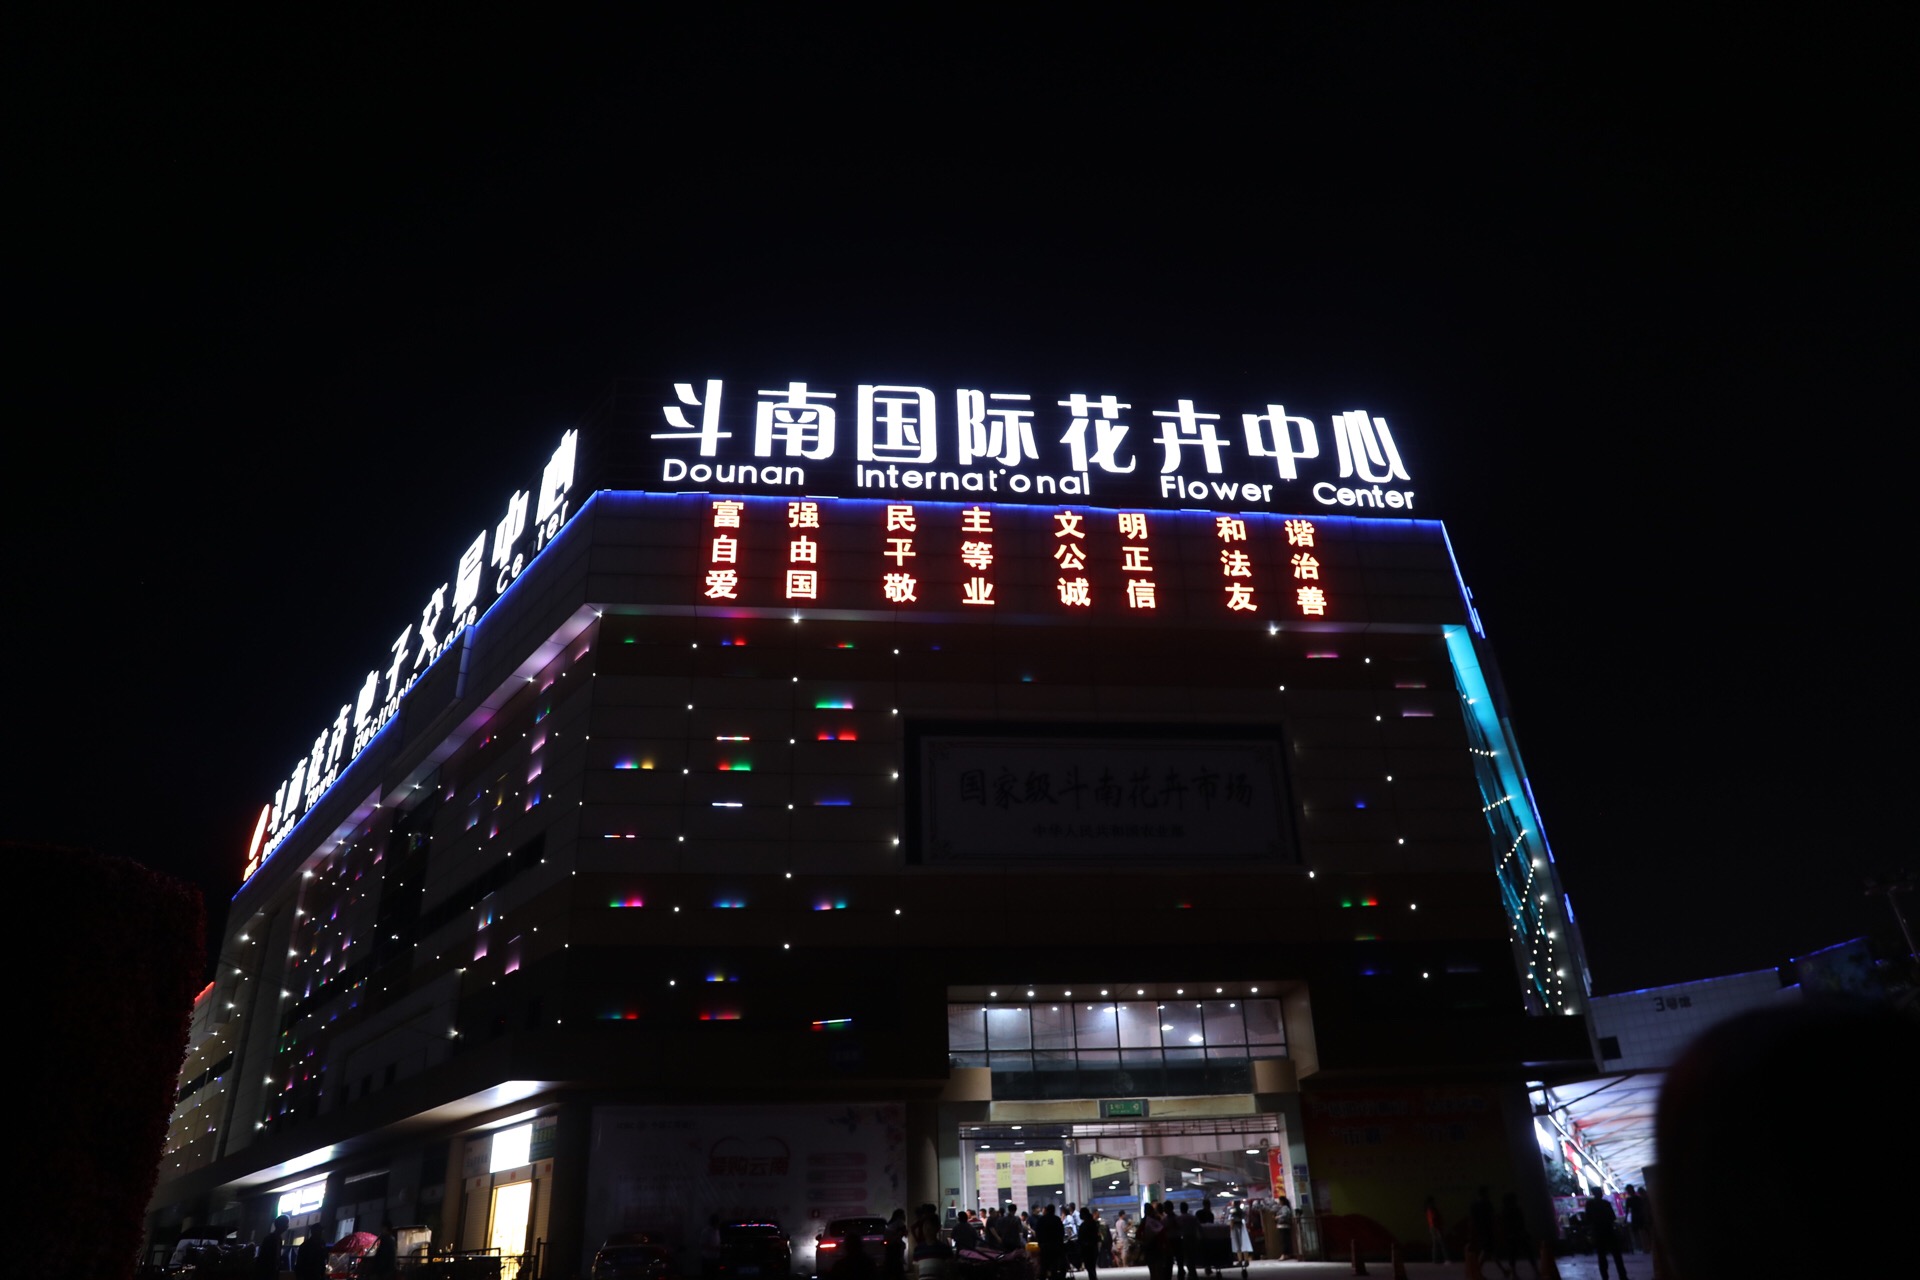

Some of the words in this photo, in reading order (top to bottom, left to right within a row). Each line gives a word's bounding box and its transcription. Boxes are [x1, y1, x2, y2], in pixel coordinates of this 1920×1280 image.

[651, 379, 1412, 483] 斗南国际花卉中心
[663, 458, 805, 485] Dounan
[1161, 476, 1273, 502] Flower
[1313, 482, 1415, 509] Center
[713, 500, 819, 528] 富强
[887, 505, 993, 533] 民主
[1054, 511, 1149, 540] 文明
[1216, 517, 1315, 547] 和谐
[712, 535, 816, 563] 自由
[884, 538, 993, 570] 平等
[1054, 543, 1152, 571] 公正
[1220, 550, 1319, 580] 法治
[430, 605, 477, 667] Trade
[496, 500, 570, 595] Ceter
[705, 570, 817, 600] 爱国
[884, 573, 994, 605] 敬业
[1057, 578, 1156, 608] 诚信
[1225, 583, 1327, 615] 友善
[959, 765, 1254, 811] 国家级斗南花卉市场
